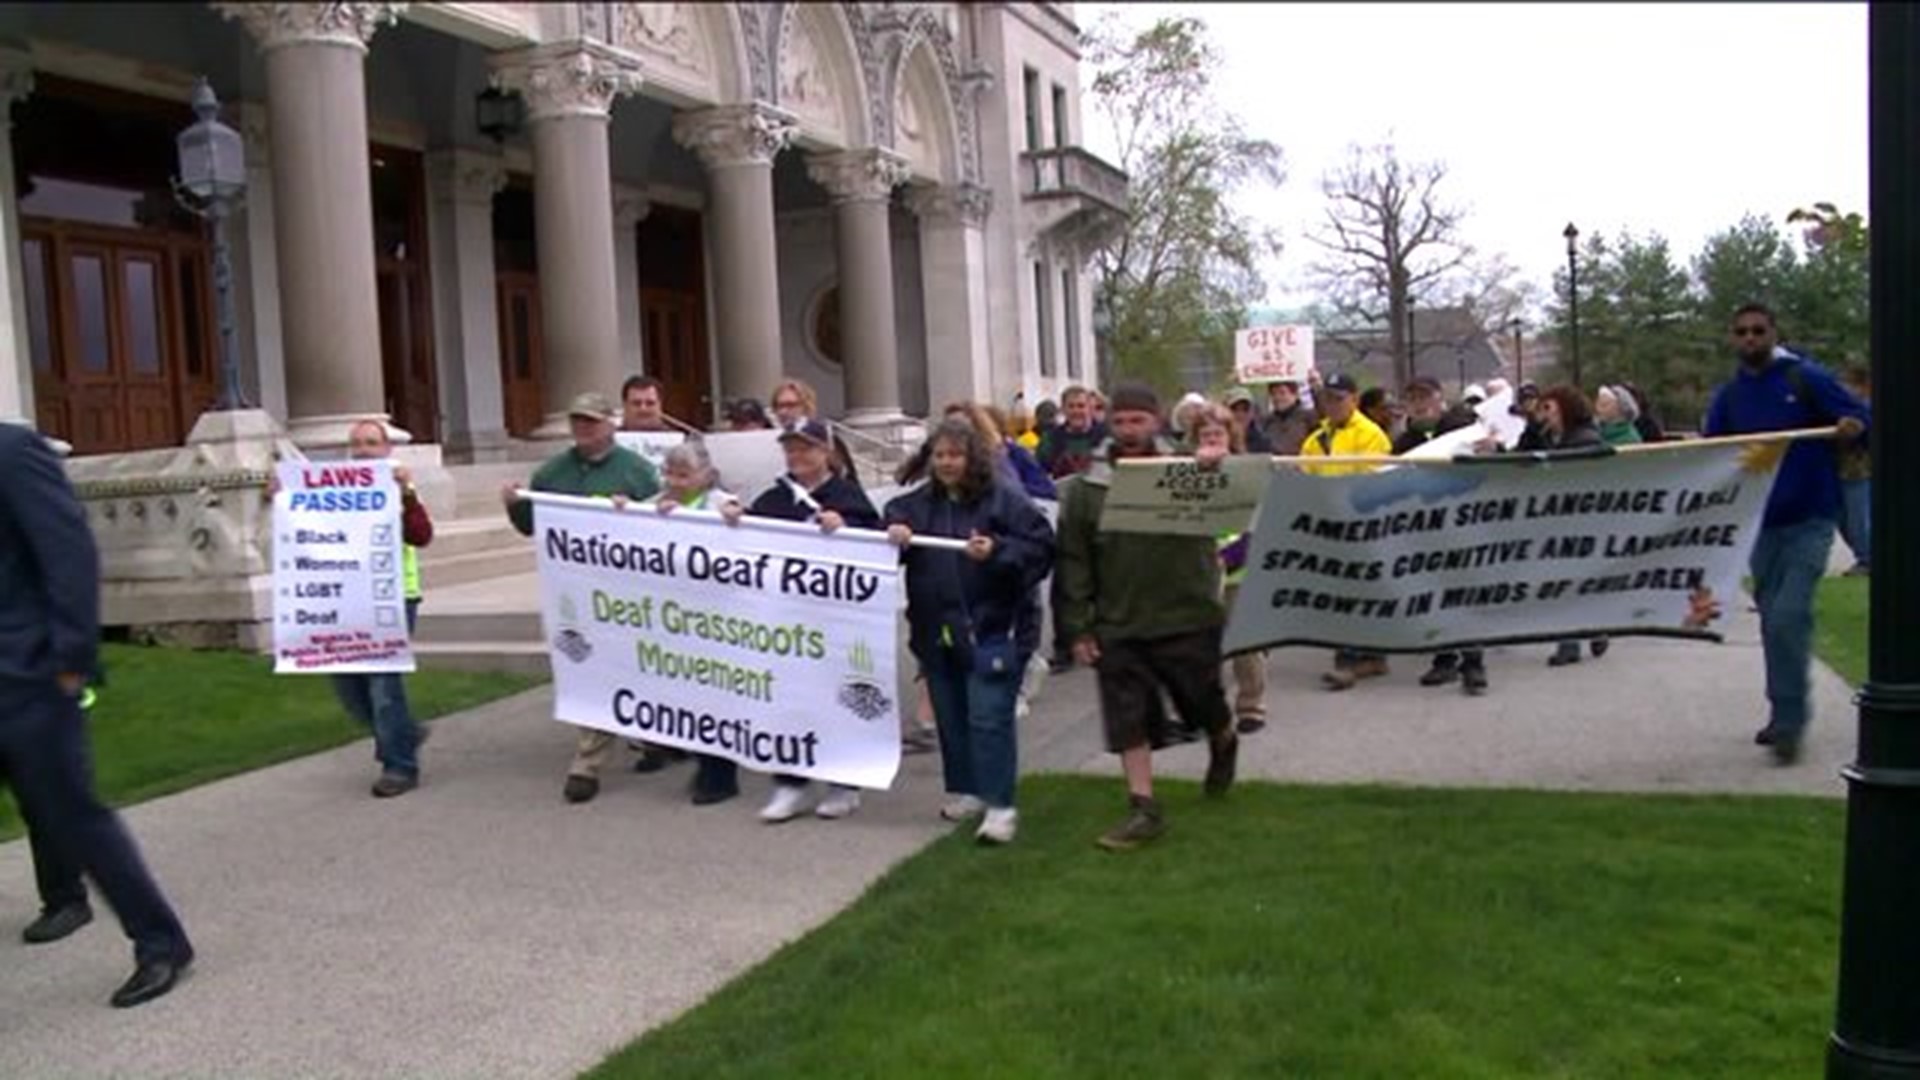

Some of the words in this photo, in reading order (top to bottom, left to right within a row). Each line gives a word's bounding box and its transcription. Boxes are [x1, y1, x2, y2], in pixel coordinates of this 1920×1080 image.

[1248, 328, 1297, 350] GIVE
[303, 467, 374, 488] LAWS
[290, 491, 387, 512] PASSED
[1291, 507, 1448, 542] AMERICAN
[1454, 496, 1518, 527] SIGN
[1526, 489, 1669, 519] LANGUAGE
[295, 530, 348, 544] Black
[294, 557, 360, 571] Women
[546, 527, 676, 576] National
[687, 545, 770, 590] Deaf
[781, 556, 878, 602] Rally
[1262, 549, 1384, 581] SPARKS
[1392, 539, 1533, 579] COGNITIVE
[1539, 535, 1597, 559] AND
[295, 583, 343, 598] LGBT
[1271, 588, 1398, 618] GROWTH
[1405, 591, 1433, 617] IN
[1439, 582, 1529, 610] MINDS
[1536, 580, 1572, 600] OF
[1577, 568, 1705, 595] CHILDREN
[295, 609, 338, 625] Deaf
[592, 588, 653, 629] Deaf
[637, 638, 775, 702] Movement
[613, 688, 819, 767] Connecticut
